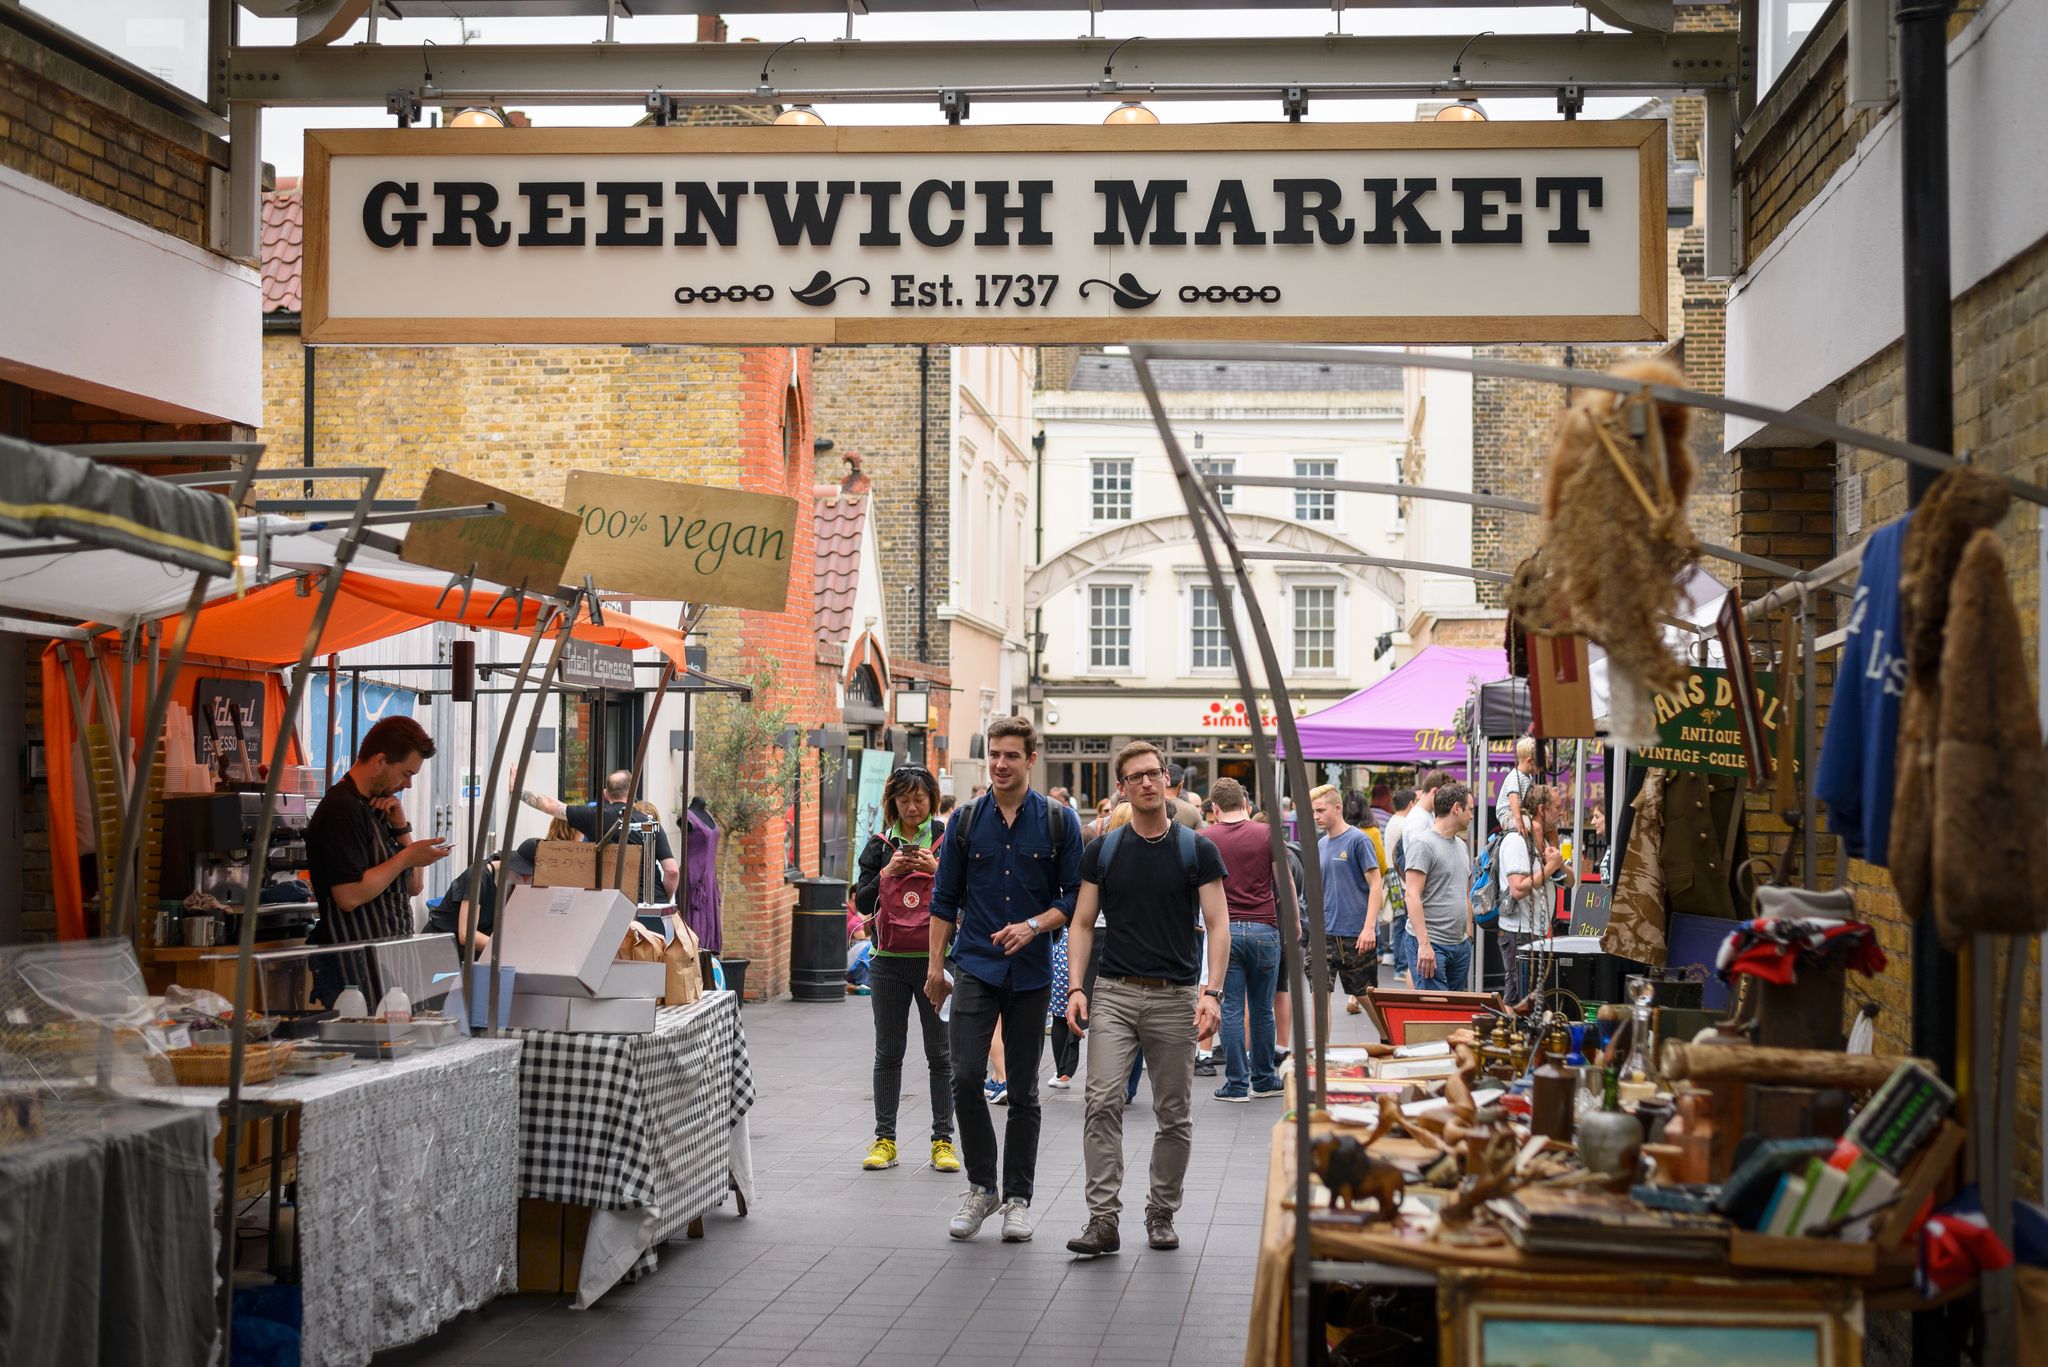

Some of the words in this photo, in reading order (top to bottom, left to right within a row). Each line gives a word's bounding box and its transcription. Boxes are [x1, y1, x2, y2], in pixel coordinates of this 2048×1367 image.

[362, 180, 1054, 249] GREENWICH
[1093, 176, 1603, 246] MARKET
[890, 273, 963, 308] Est.
[975, 273, 1060, 308] 1737
[659, 514, 785, 576] vegan
[592, 648, 632, 684] Espresso
[1648, 674, 1706, 734] ANS
[1414, 728, 1457, 752] The
